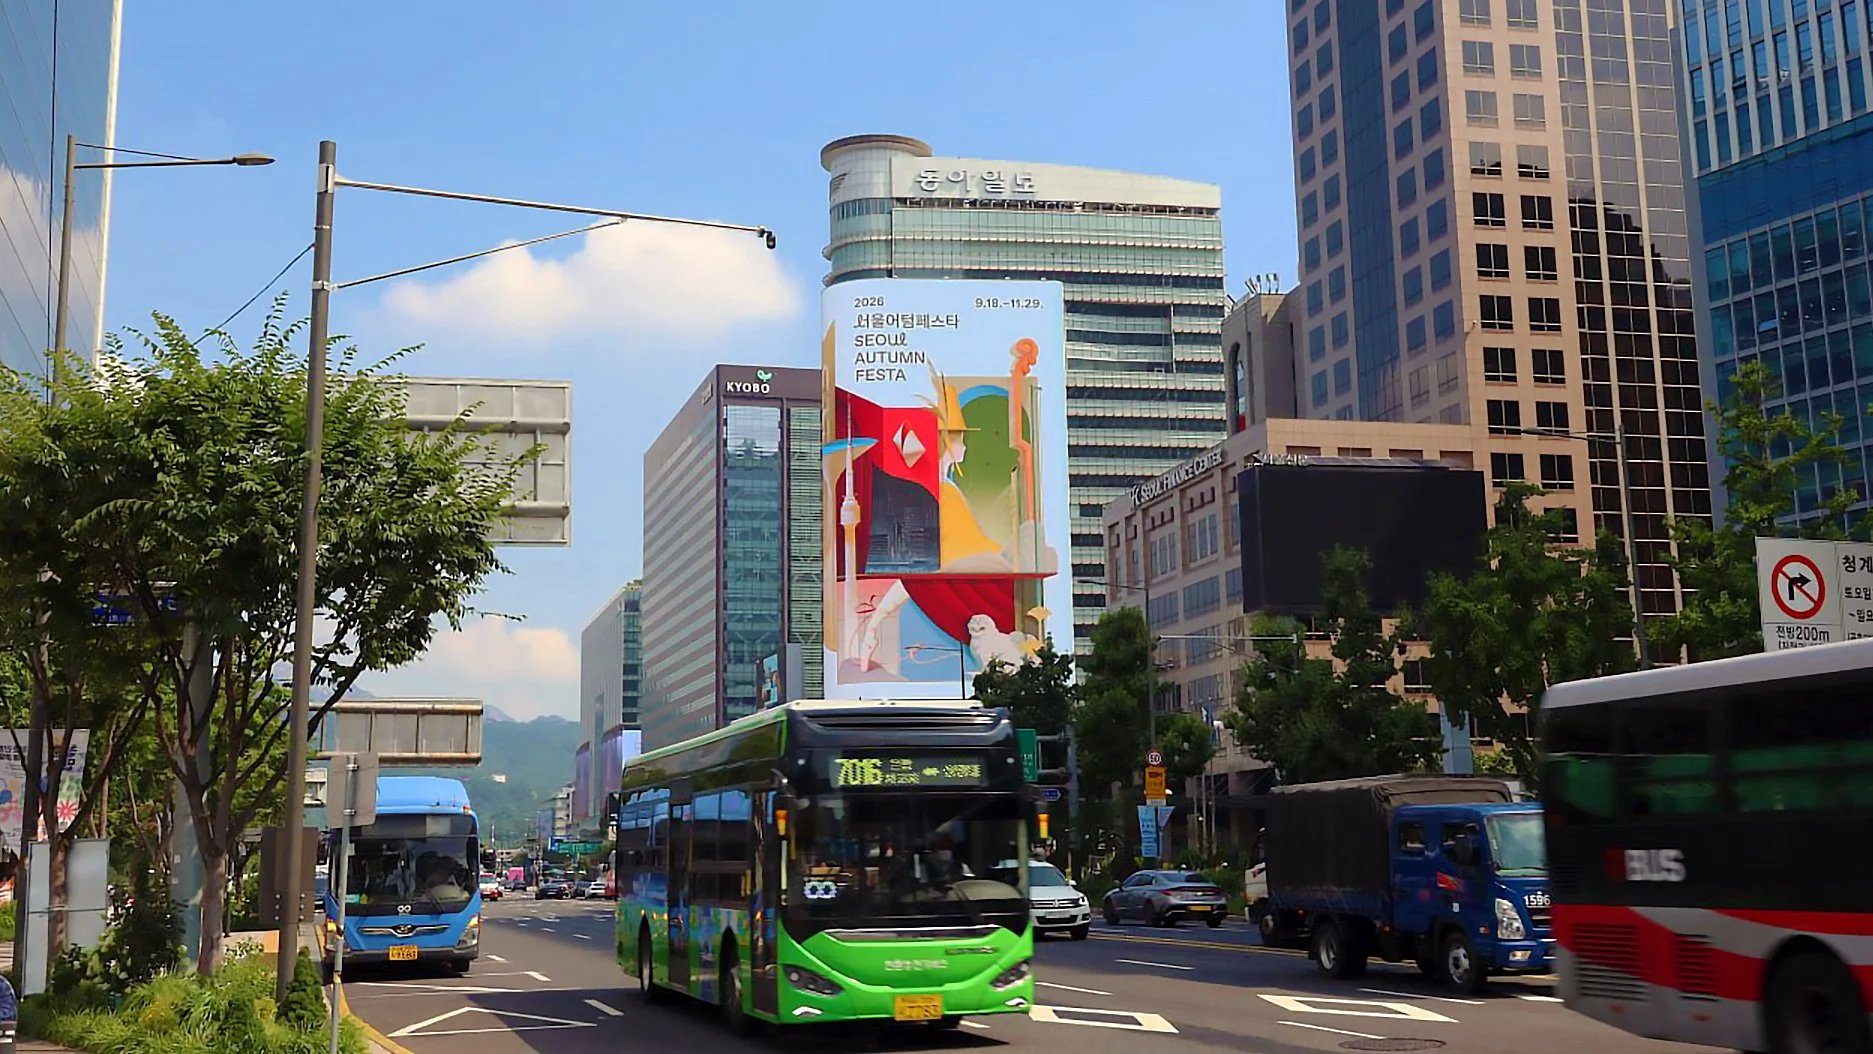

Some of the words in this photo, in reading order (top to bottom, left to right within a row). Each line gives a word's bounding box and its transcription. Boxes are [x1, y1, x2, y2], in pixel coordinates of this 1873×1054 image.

[914, 168, 1037, 194] 동아일보
[854, 297, 885, 308] 2026
[853, 313, 960, 329] 서울어텀페스타
[854, 332, 907, 347] SEOUL
[855, 351, 925, 365] AUTUMN
[855, 368, 907, 382] FESTA
[726, 381, 770, 394] KYOBO
[1624, 849, 1687, 882] BUS
[1523, 895, 1551, 905] 1596
